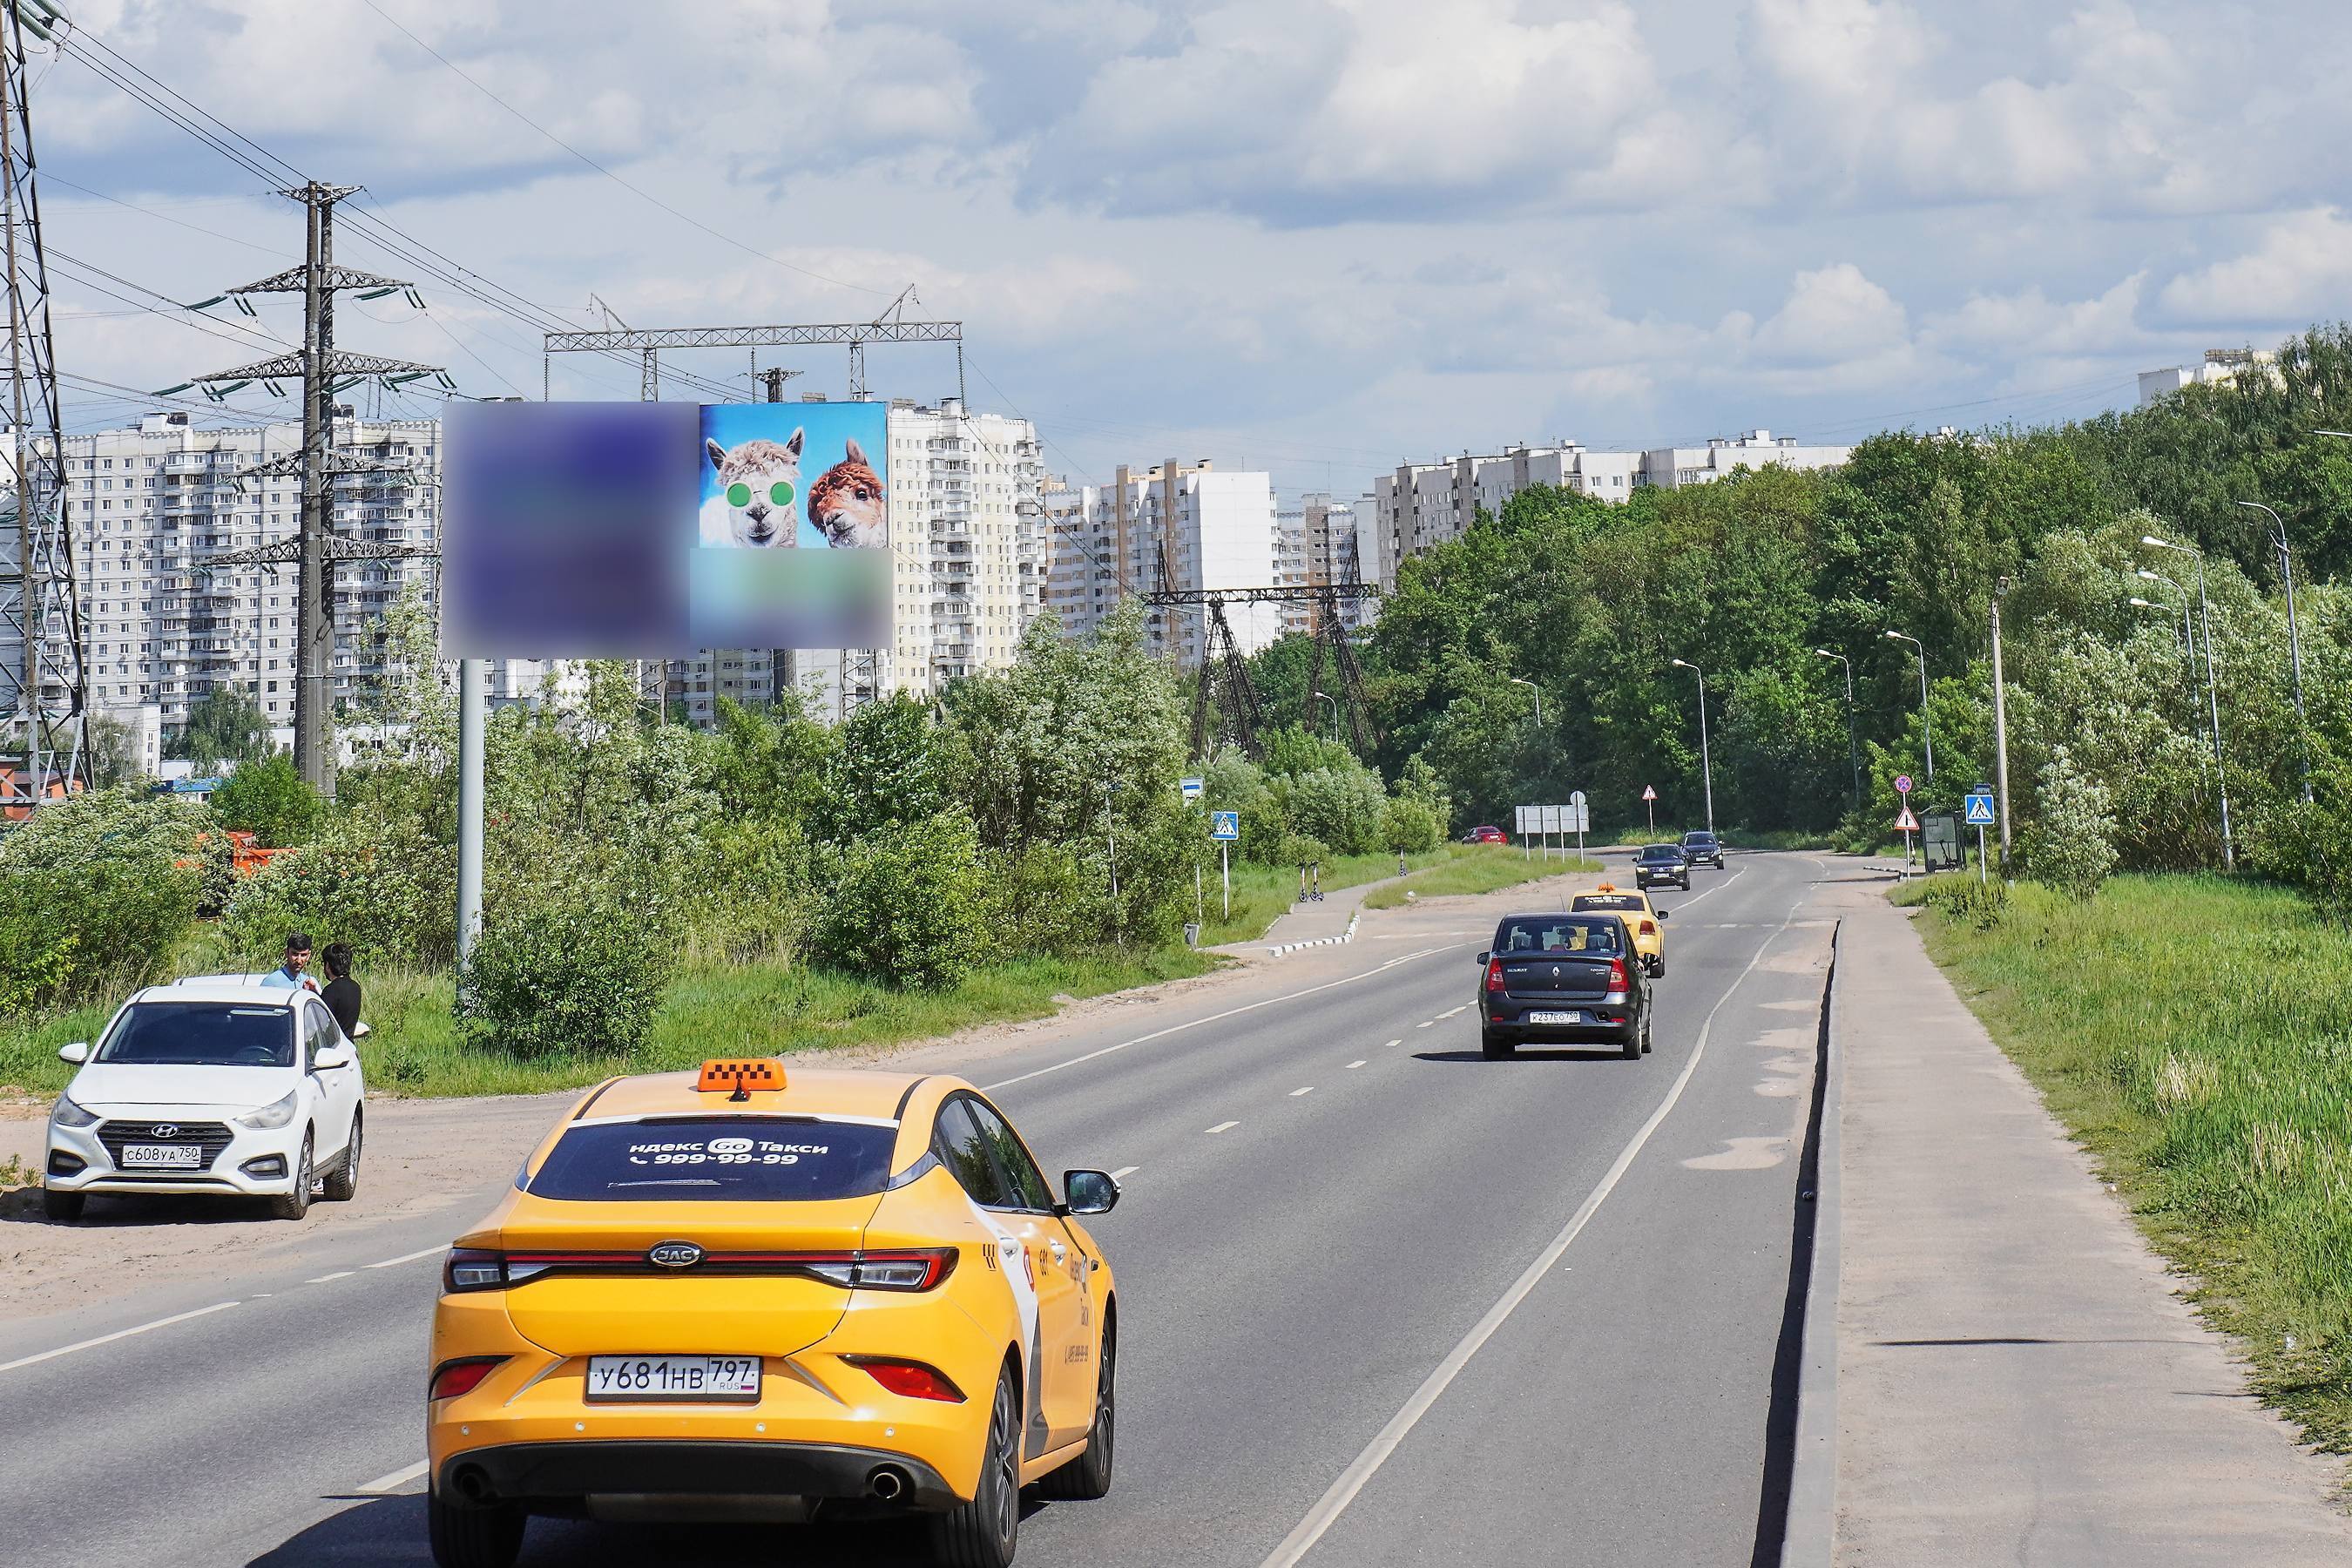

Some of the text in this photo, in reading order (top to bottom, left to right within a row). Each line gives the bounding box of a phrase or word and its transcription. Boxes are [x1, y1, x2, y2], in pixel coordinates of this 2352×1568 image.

[179, 1147, 198, 1158] 750
[758, 1140, 828, 1154] Такси
[711, 1360, 752, 1382] 797
[720, 1382, 740, 1390] RUS
